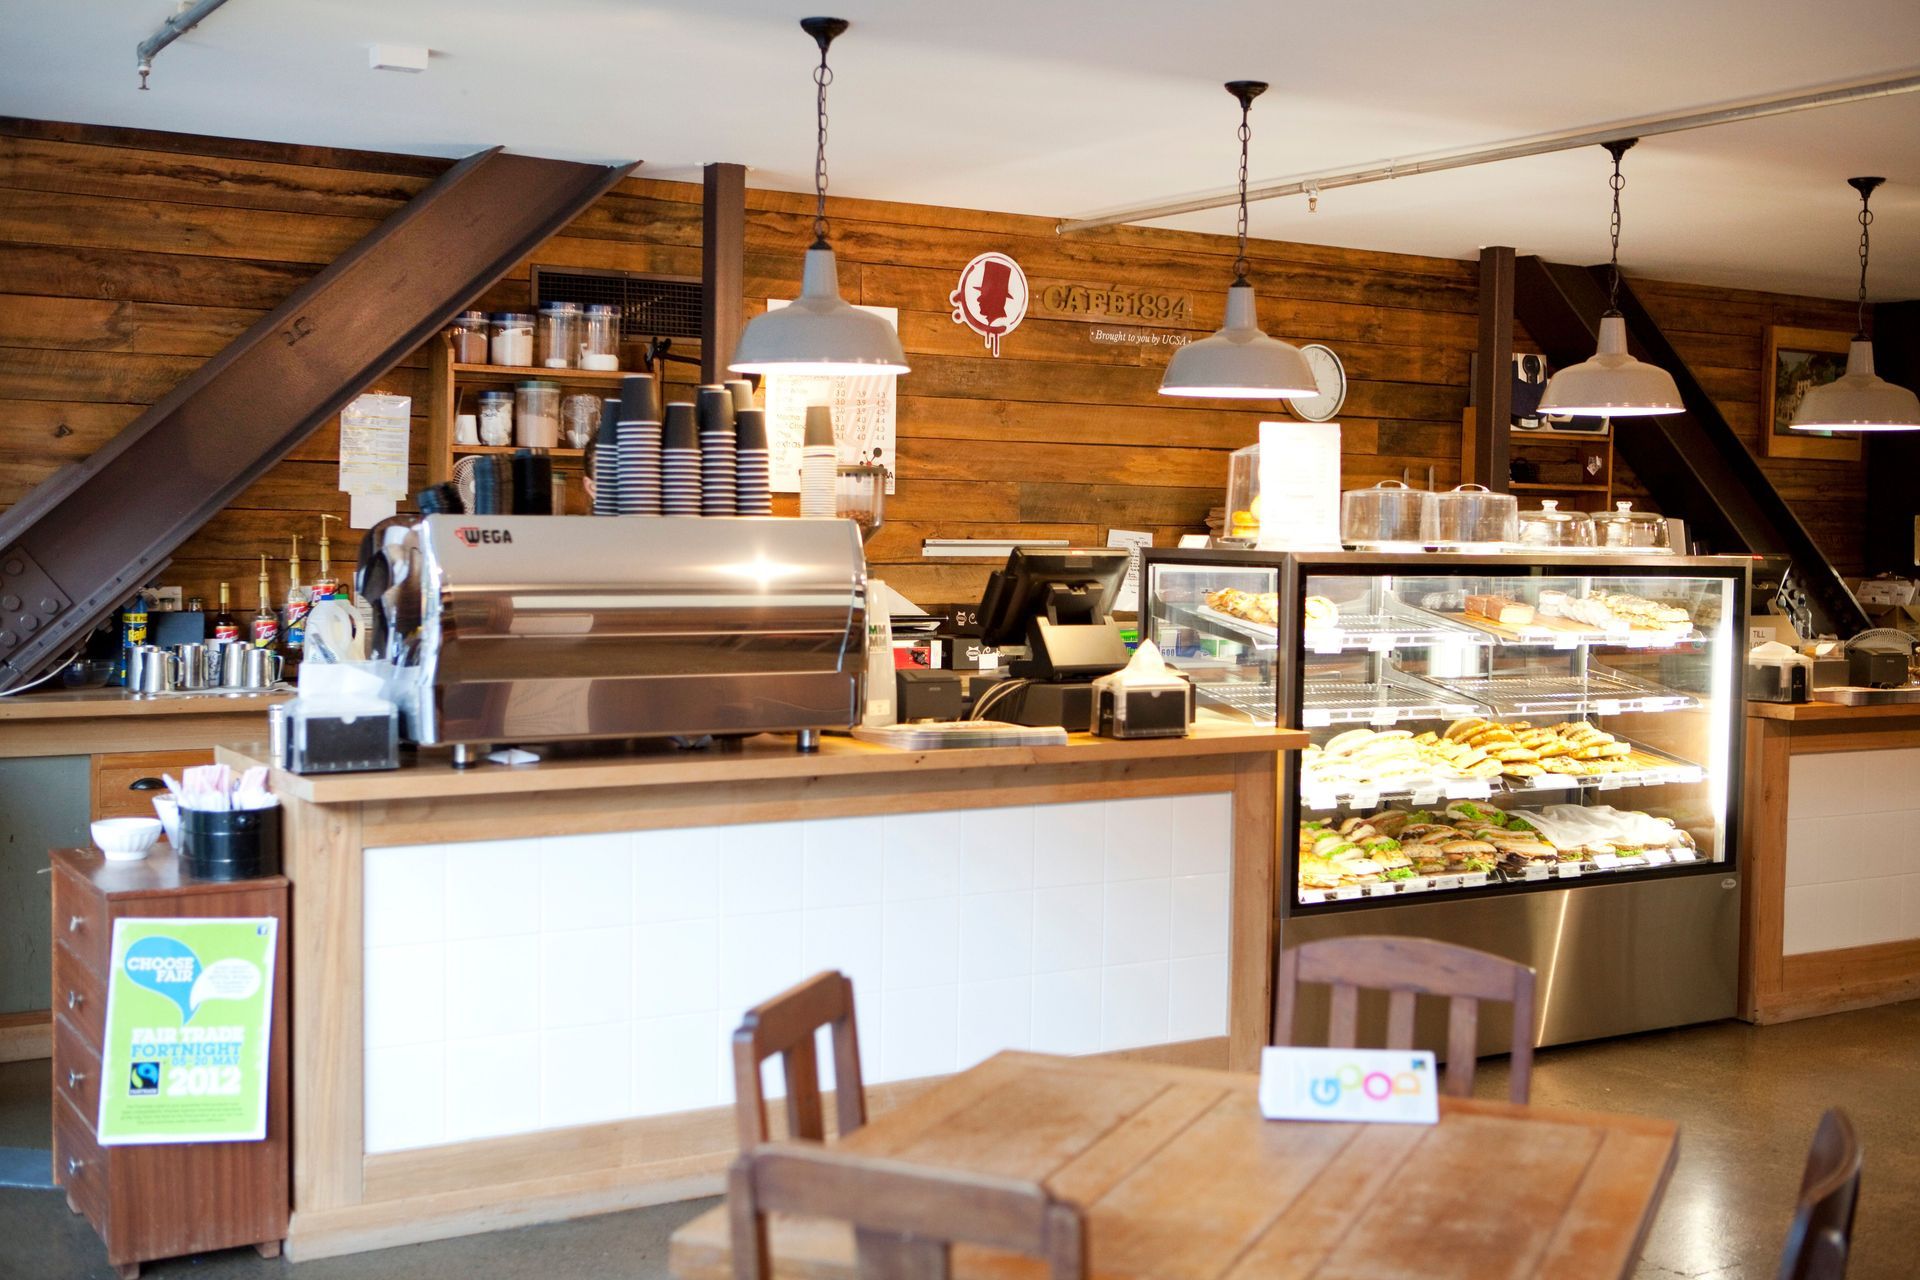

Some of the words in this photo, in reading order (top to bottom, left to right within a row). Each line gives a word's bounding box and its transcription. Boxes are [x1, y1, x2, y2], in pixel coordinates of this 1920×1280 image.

[1095, 329, 1126, 341] Brought
[1128, 332, 1136, 341] to
[1136, 335, 1150, 344] you
[1151, 333, 1161, 345] by
[1162, 335, 1187, 345] UCSA
[463, 528, 513, 544] WEGA
[127, 956, 194, 971] CHOOSE
[155, 969, 193, 983] FAIR
[131, 1027, 177, 1043] FAIR
[180, 1024, 245, 1042] TRADE
[131, 1041, 242, 1058] FORTNIGHT
[212, 1055, 240, 1066] MAY
[166, 1065, 241, 1096] 2012
[1310, 1063, 1421, 1105] GOOD
